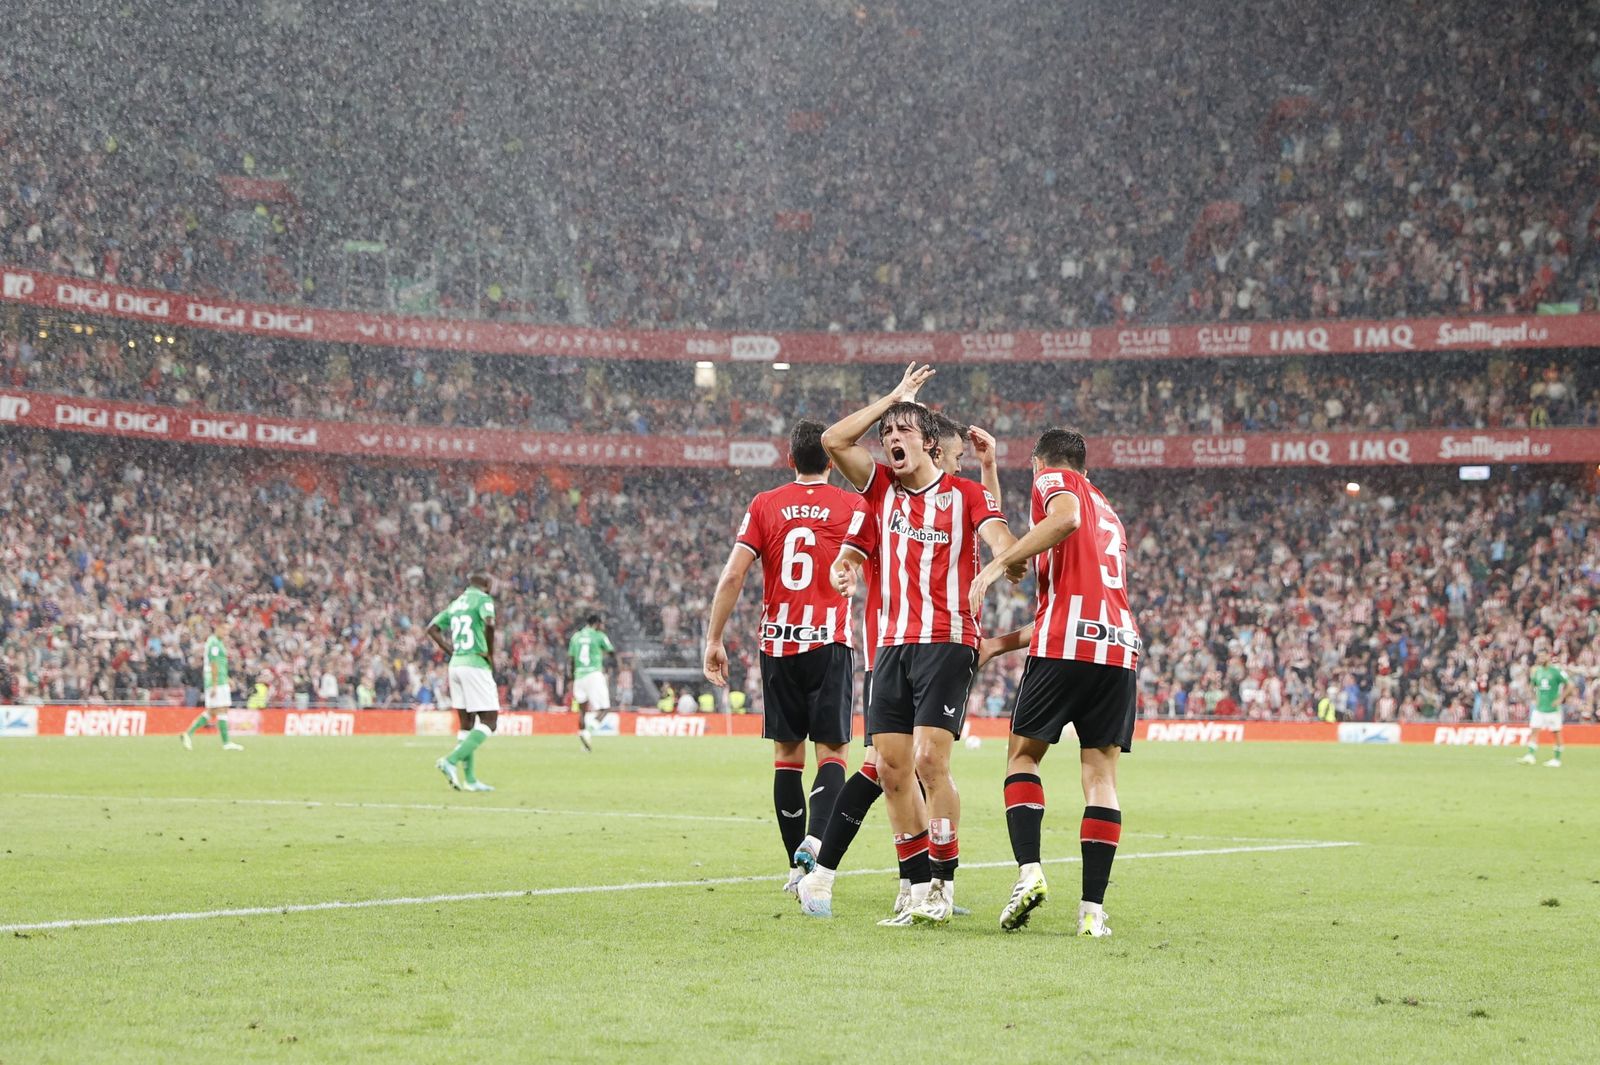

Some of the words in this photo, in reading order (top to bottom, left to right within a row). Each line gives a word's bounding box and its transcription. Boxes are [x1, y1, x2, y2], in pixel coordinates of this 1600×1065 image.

[57, 284, 109, 309] DIGI
[116, 293, 169, 317] DIGI
[187, 303, 245, 327] DIGI
[252, 311, 313, 333] DIGI
[961, 332, 1014, 350] CLUB
[1040, 331, 1092, 348] CLUB
[1118, 329, 1170, 346] CLUB
[1197, 326, 1251, 344] CLUB
[1269, 327, 1330, 351] IMQ
[1353, 324, 1415, 349] IMQ
[55, 404, 109, 427] DIGI
[114, 410, 168, 433] DIGI
[190, 418, 248, 441] DIGI
[256, 423, 318, 446] DIGI
[1112, 439, 1165, 455] CLUB
[1192, 438, 1246, 454] CLUB
[1270, 439, 1331, 464] IMQ
[1349, 437, 1412, 463] IMQ
[780, 505, 831, 522] VESGA
[890, 511, 948, 543] Kutxabank
[781, 527, 816, 591] 6
[1098, 517, 1124, 590] 3
[450, 614, 475, 651] 23
[763, 624, 829, 642] DIGI
[65, 709, 147, 737] ENERYETI
[284, 712, 355, 737] ENERYETI
[1146, 722, 1244, 743] ENERYETI
[1433, 725, 1532, 746] ENERYET
